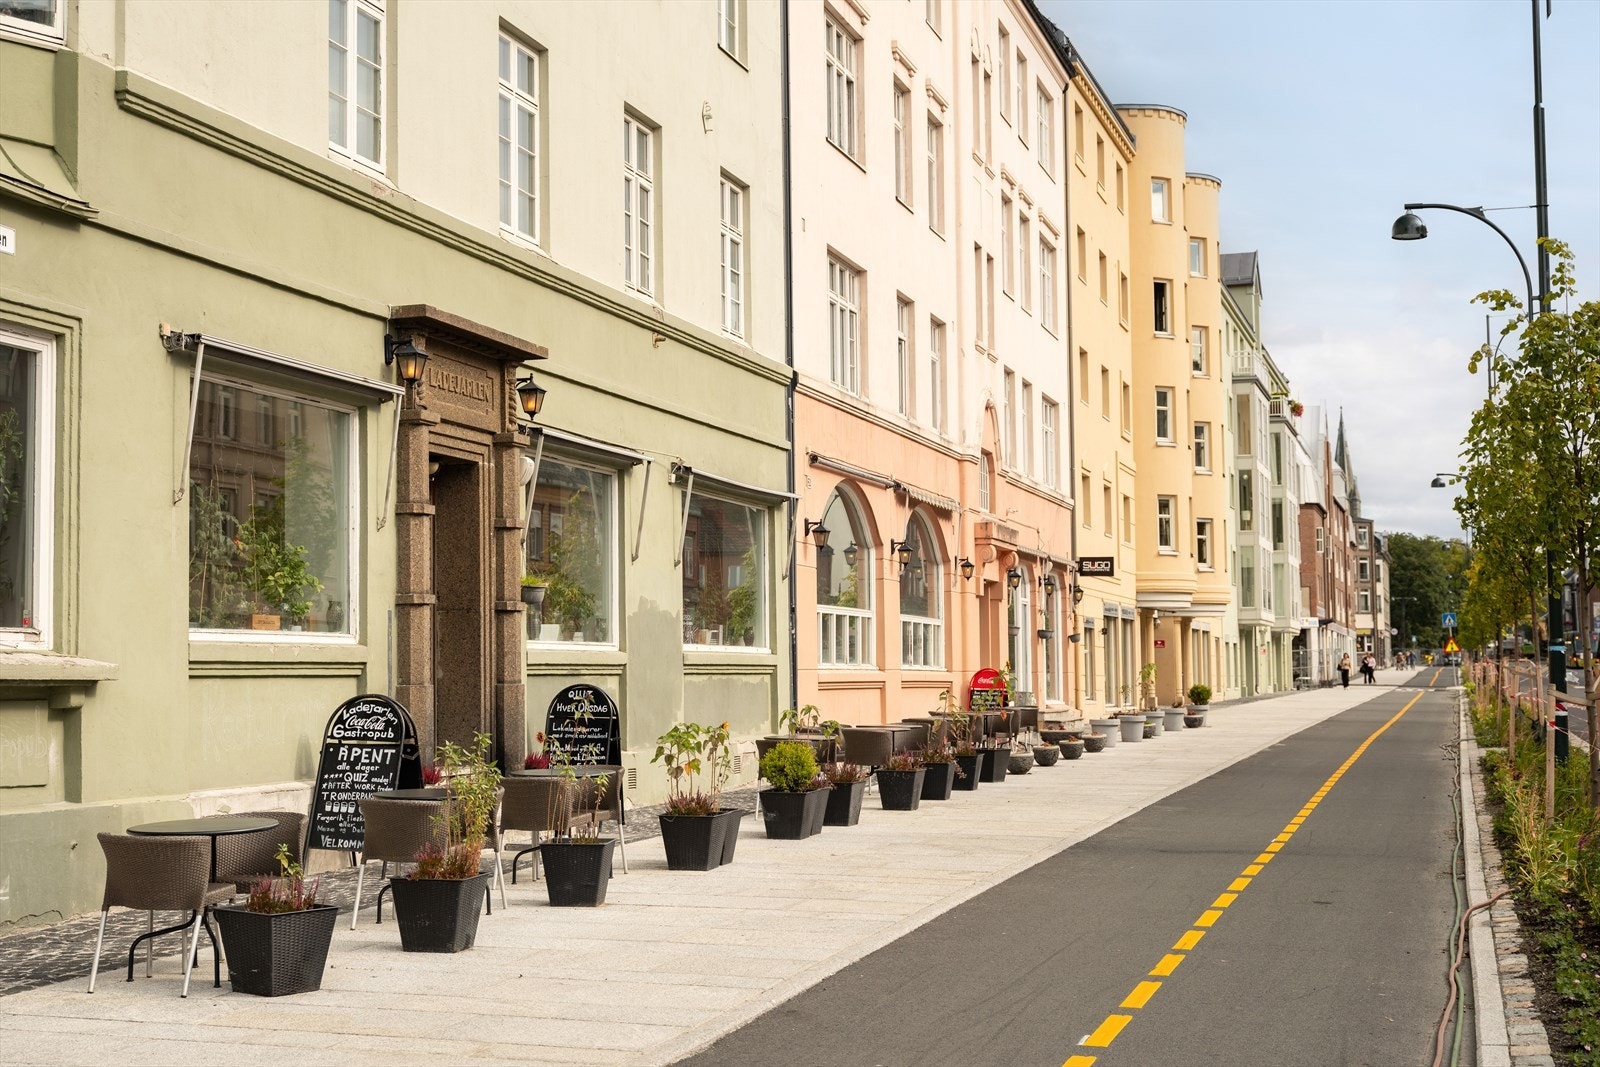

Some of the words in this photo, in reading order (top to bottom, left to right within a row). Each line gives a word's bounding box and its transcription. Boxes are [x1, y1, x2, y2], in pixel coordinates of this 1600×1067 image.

[1082, 561, 1111, 569] SUGO
[333, 724, 395, 740] Gastropub
[337, 745, 396, 765] ÅPENT
[336, 762, 350, 770] alle
[355, 762, 380, 773] dager
[344, 772, 368, 784] QUIZ
[328, 782, 351, 790] AFTER
